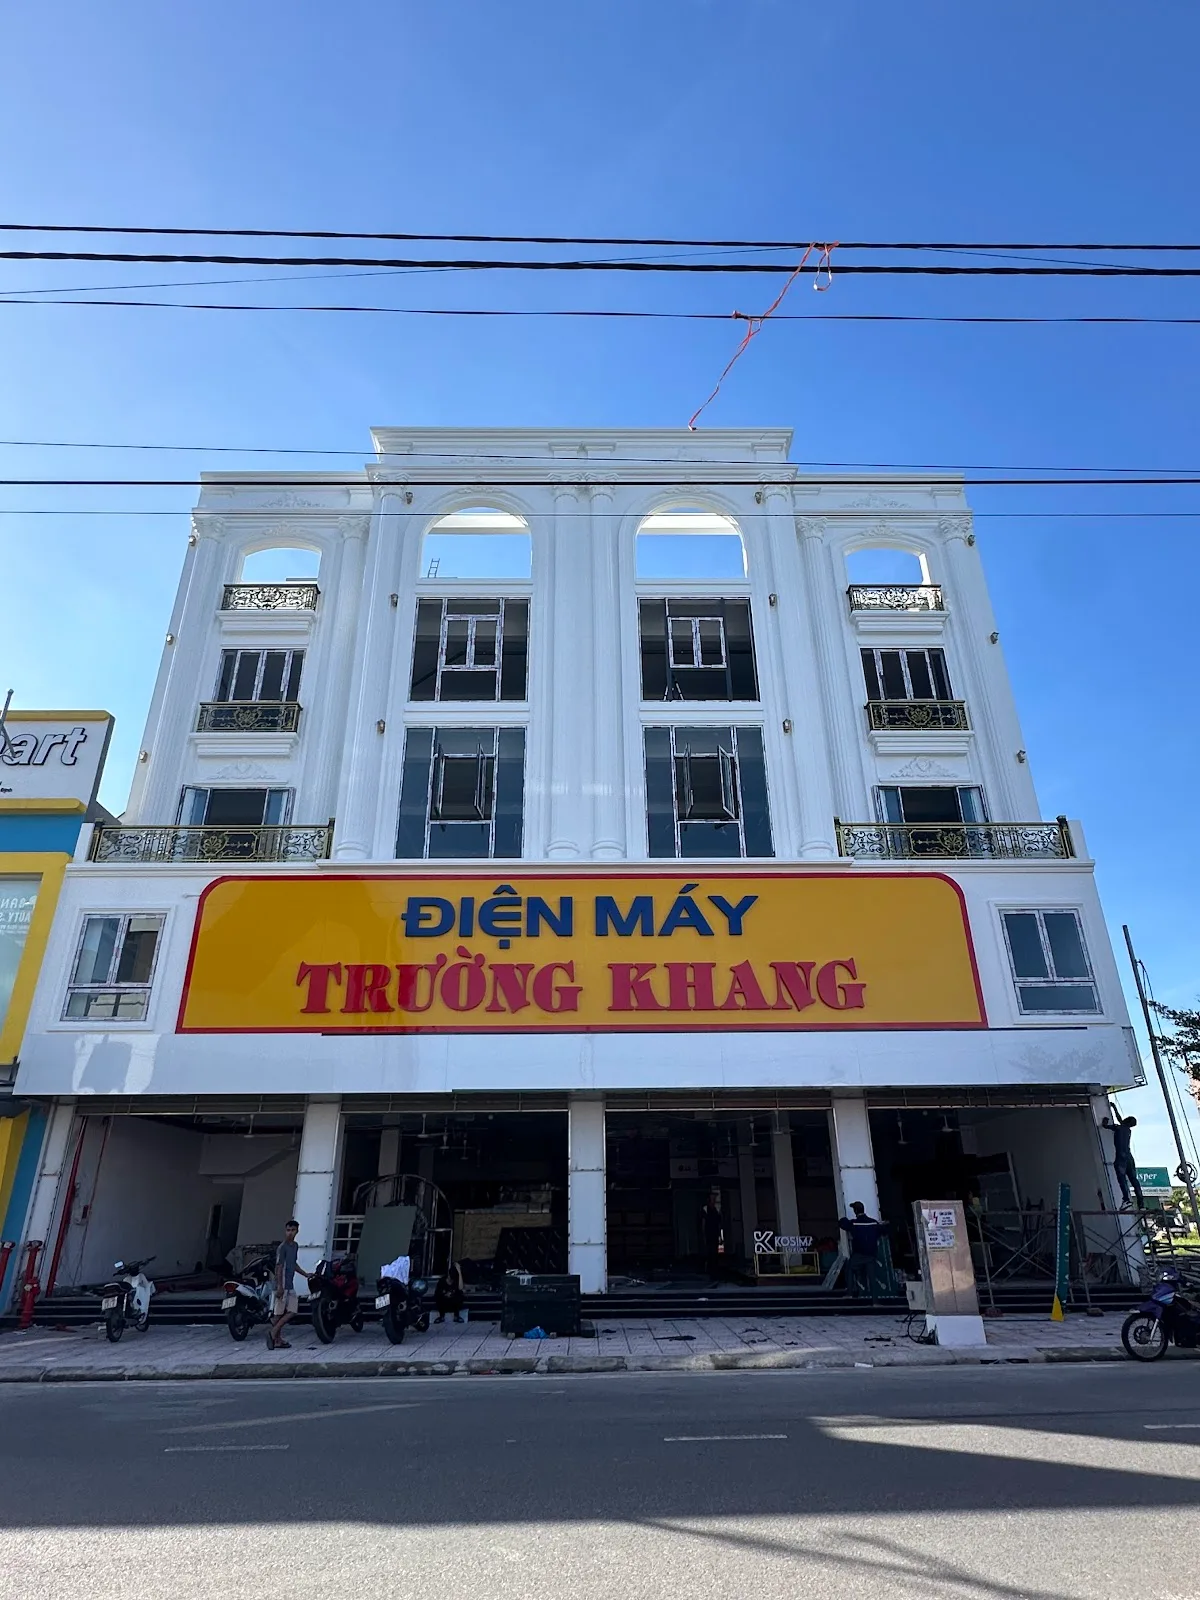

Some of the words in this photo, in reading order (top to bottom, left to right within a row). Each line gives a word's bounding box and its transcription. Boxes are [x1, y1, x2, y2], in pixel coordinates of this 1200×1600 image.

[401, 885, 574, 949] ĐIỆN
[595, 883, 760, 937] MÁY
[296, 945, 583, 1014] TRƯỜNG
[606, 957, 867, 1013] KHANG
